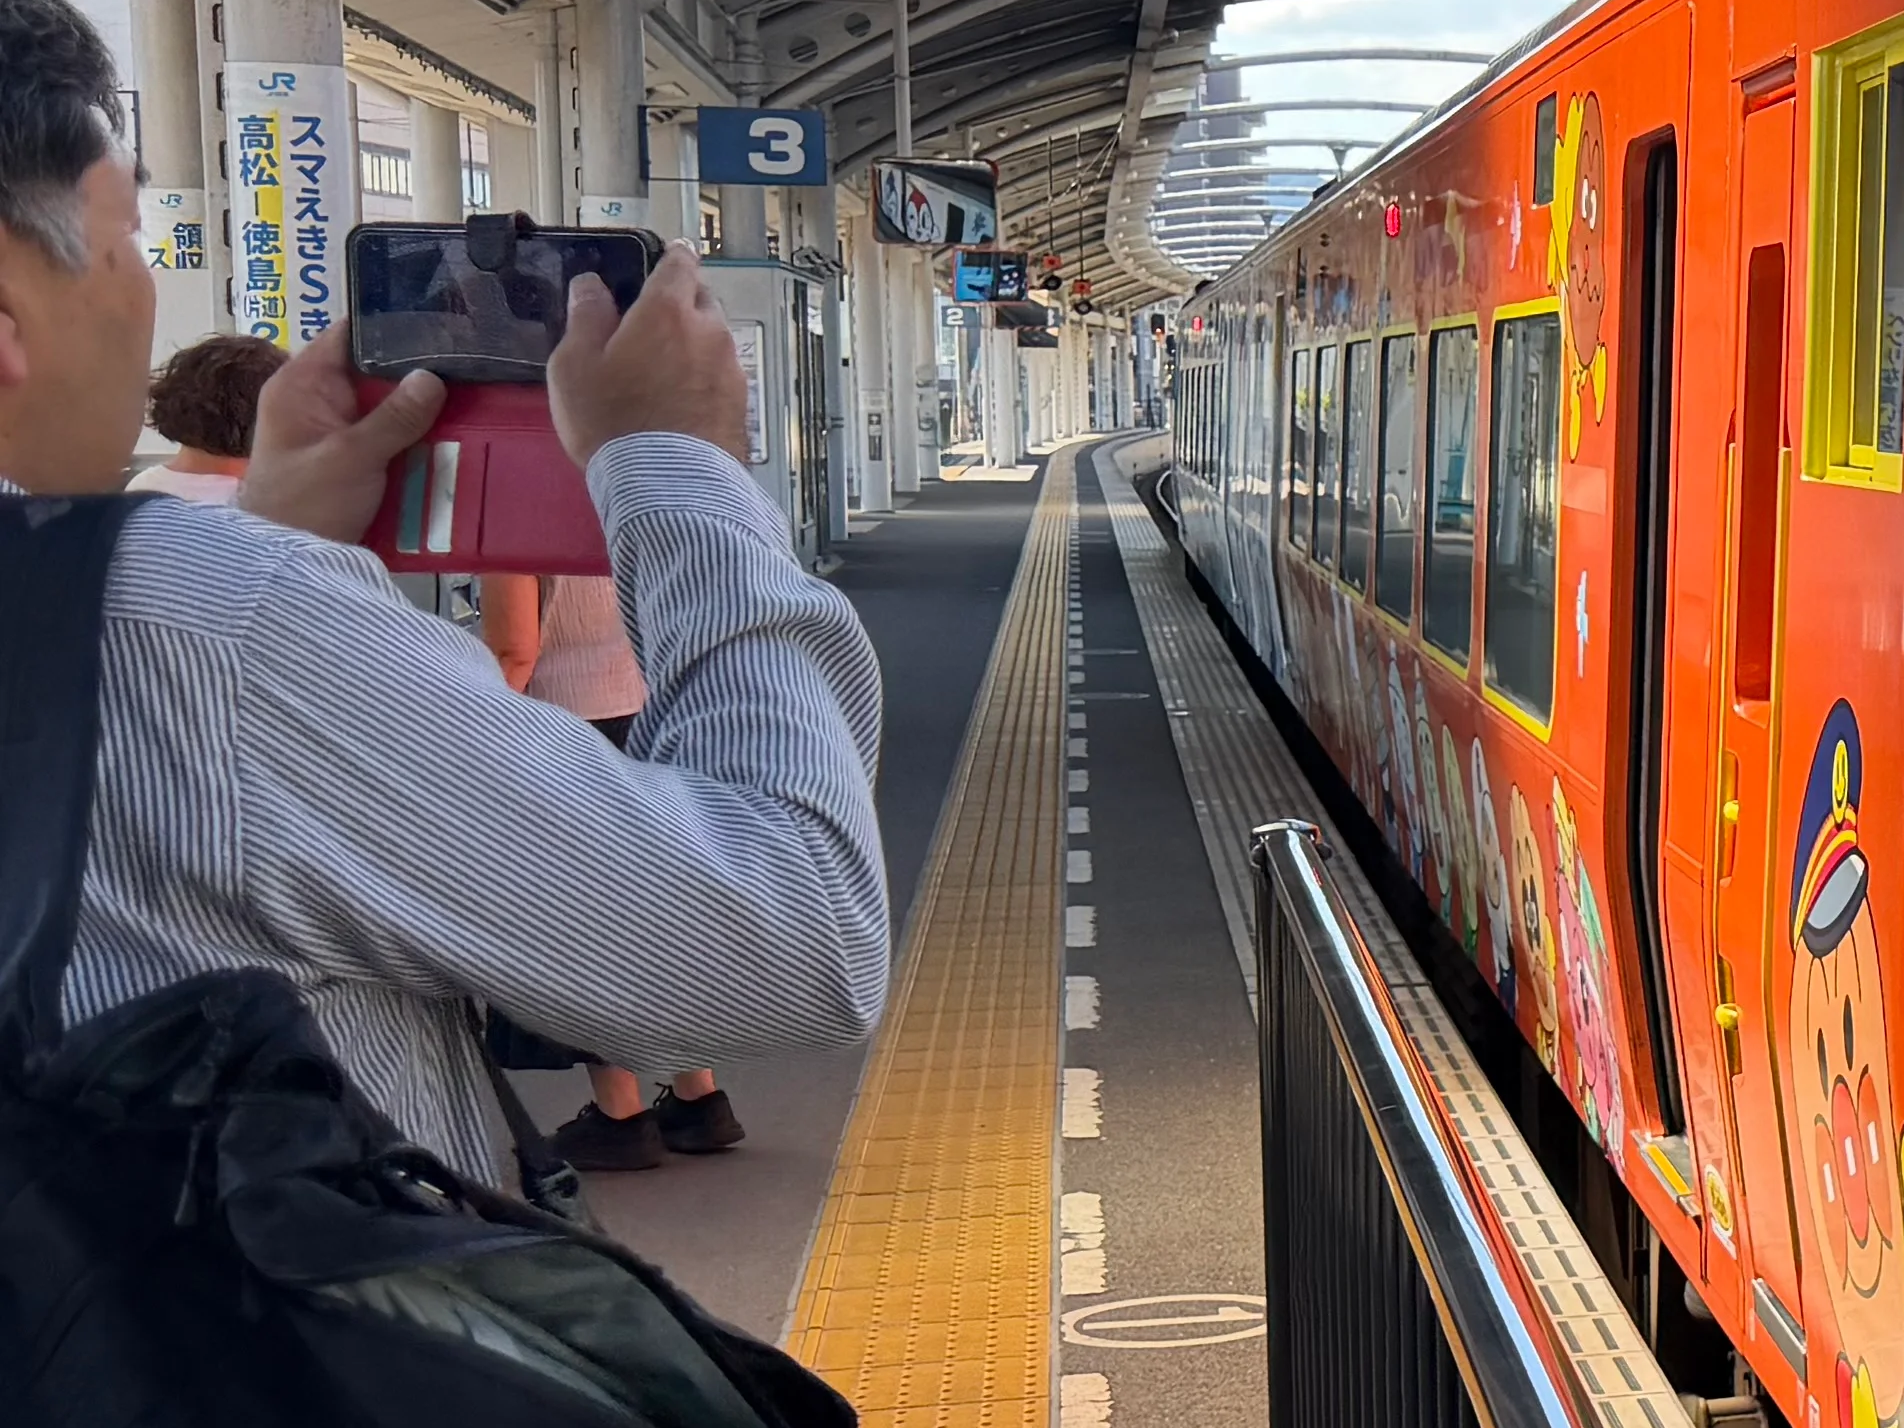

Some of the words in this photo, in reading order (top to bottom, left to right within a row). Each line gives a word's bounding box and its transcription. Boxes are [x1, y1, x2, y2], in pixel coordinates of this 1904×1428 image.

[259, 72, 296, 91] JR
[748, 117, 805, 175] 3
[946, 307, 964, 326] 2
